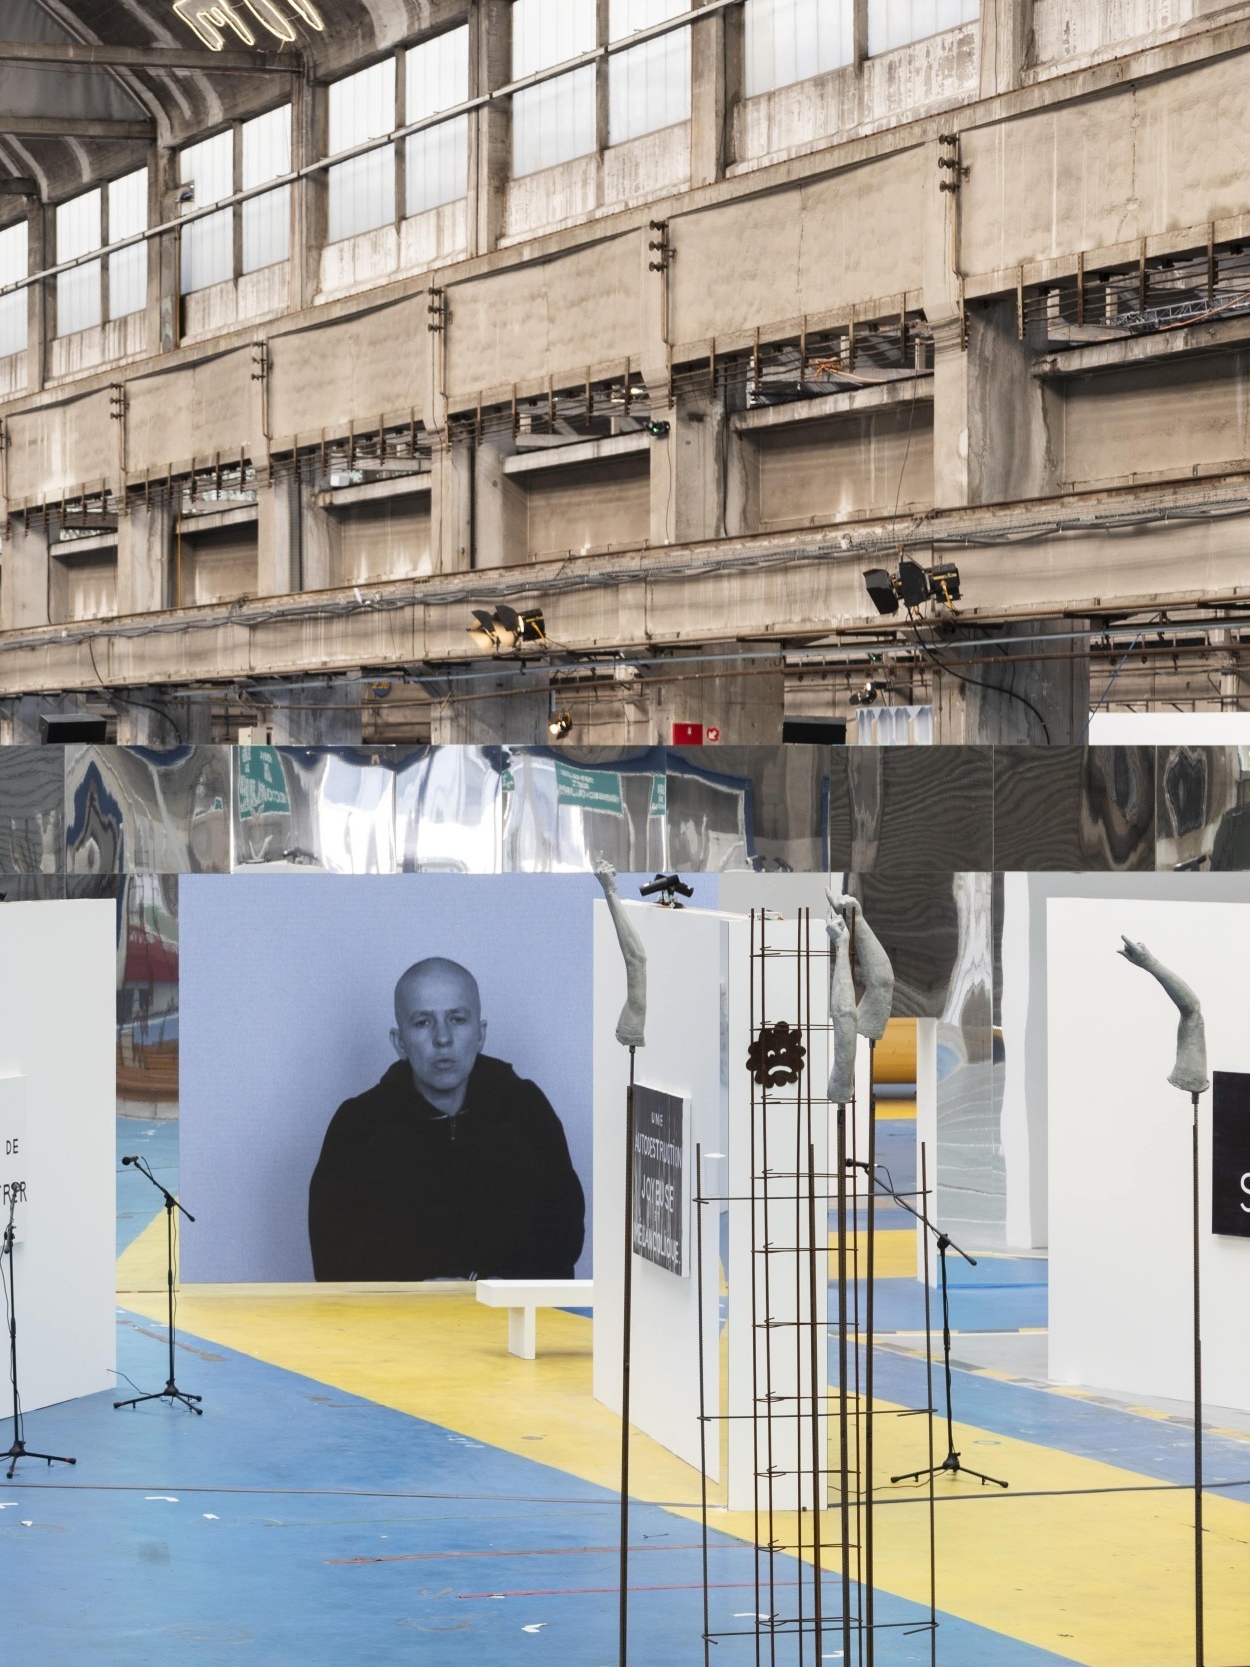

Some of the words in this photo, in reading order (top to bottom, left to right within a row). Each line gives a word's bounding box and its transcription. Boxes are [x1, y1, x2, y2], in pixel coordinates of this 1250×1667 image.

[651, 1111, 664, 1127] UNE
[6, 1138, 20, 1156] DE
[641, 1173, 674, 1214] JOYEUSE
